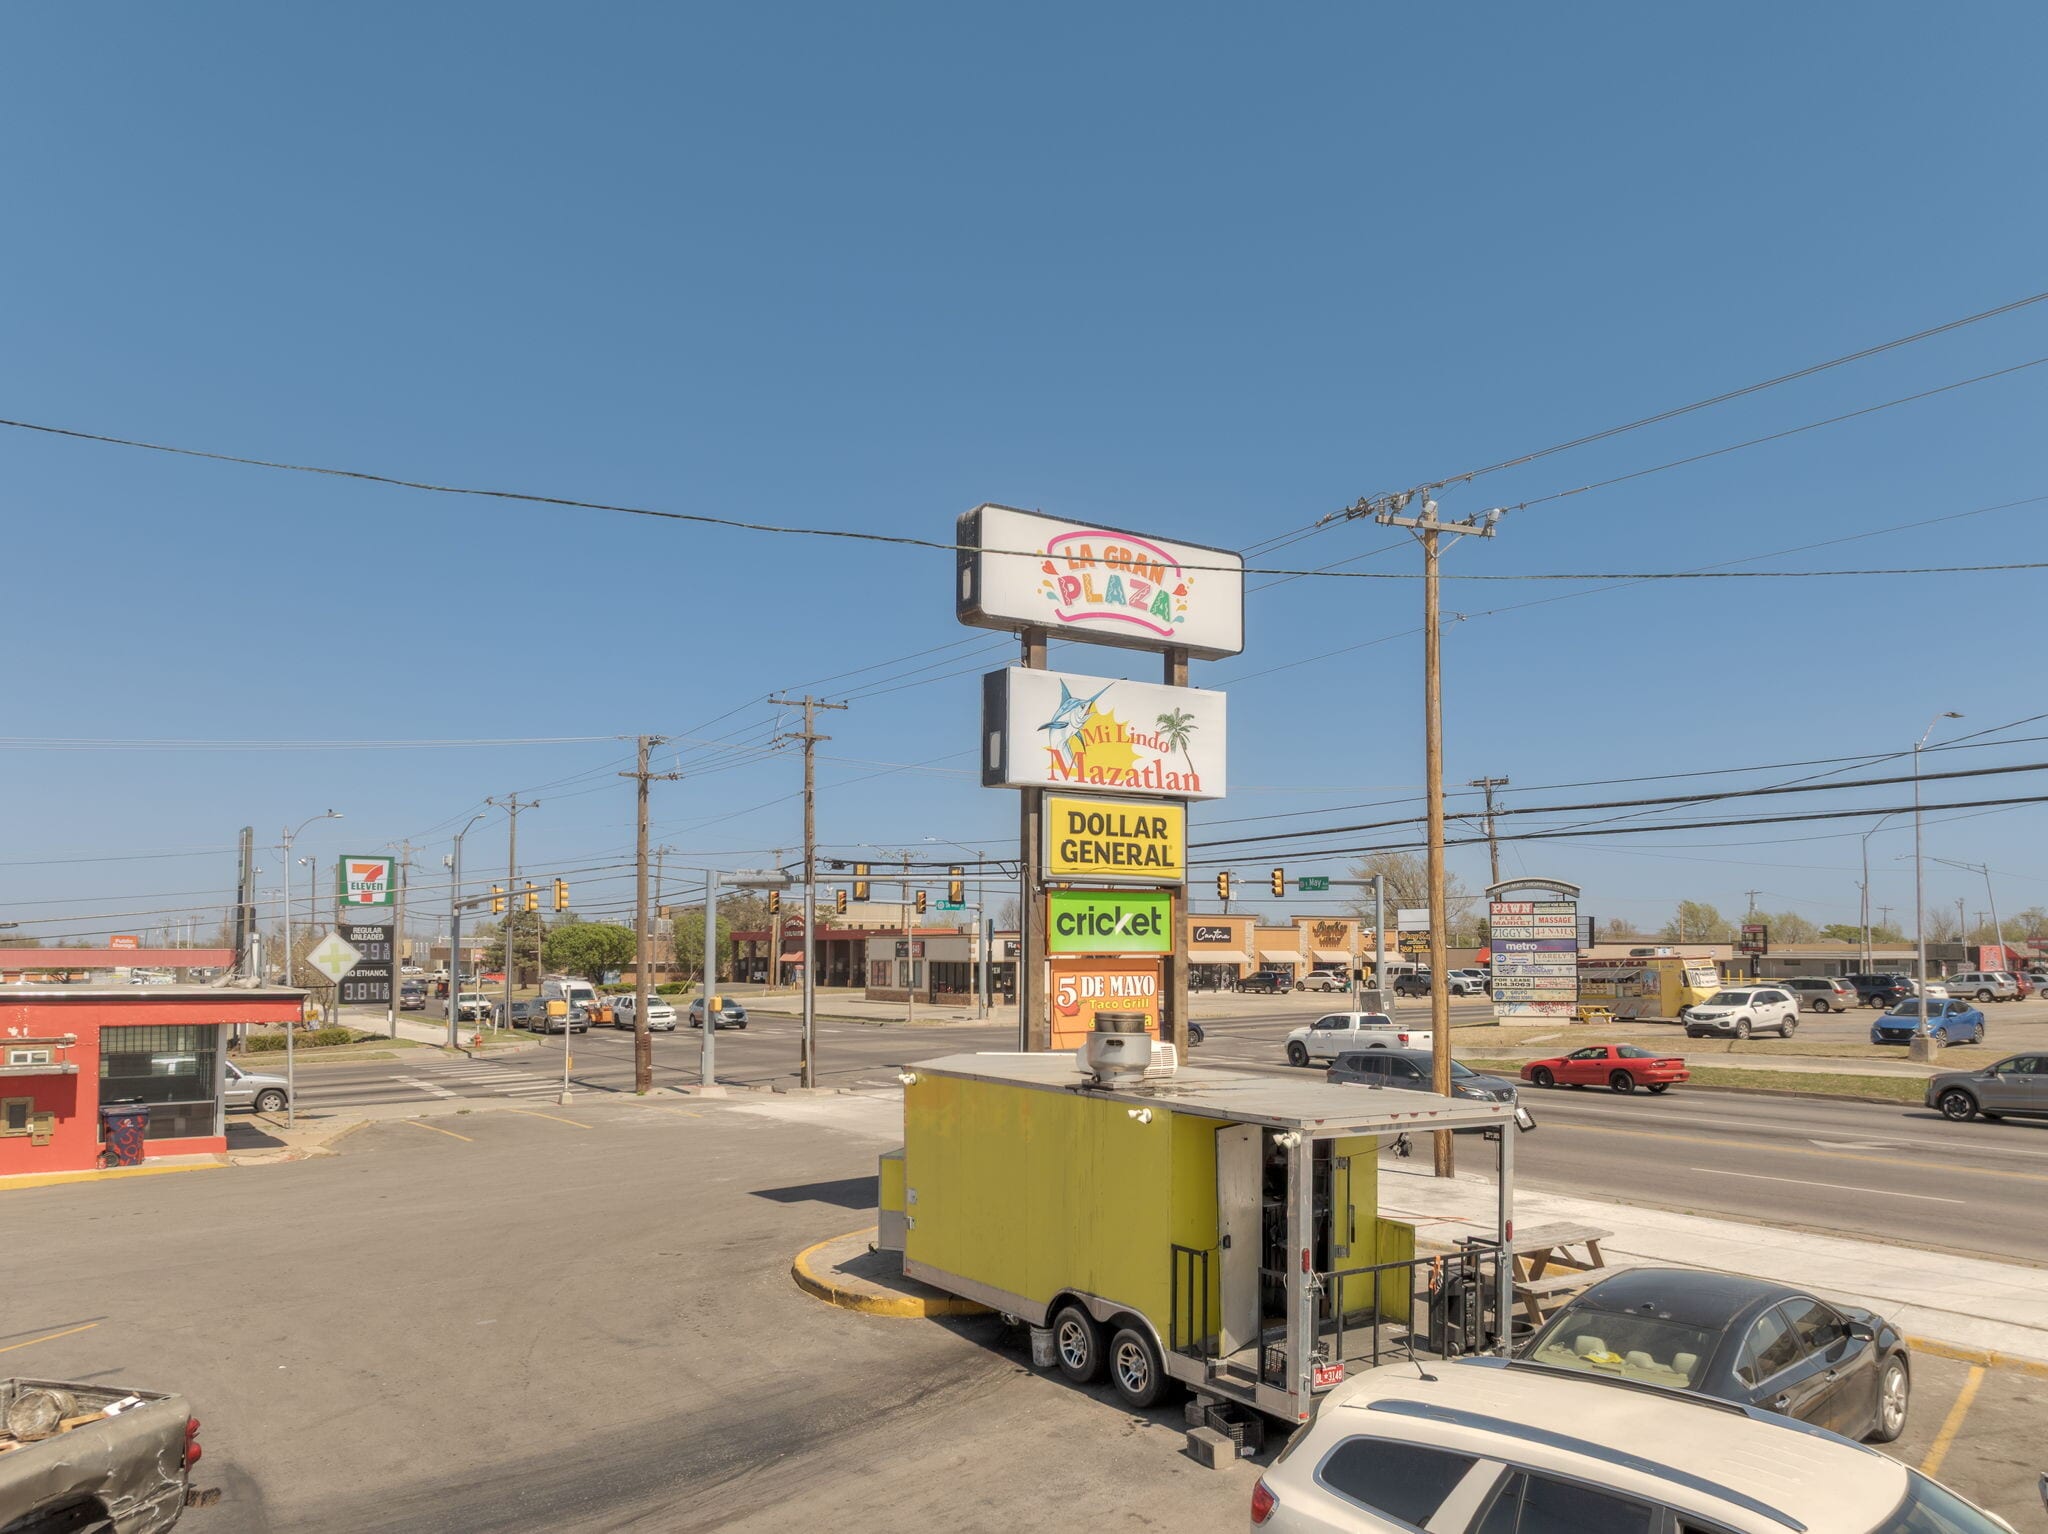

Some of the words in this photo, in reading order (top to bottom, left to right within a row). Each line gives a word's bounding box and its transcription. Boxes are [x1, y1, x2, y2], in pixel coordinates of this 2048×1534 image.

[1065, 543, 1096, 571] LA
[1103, 545, 1166, 587] GRAN
[1057, 573, 1171, 622] PLAZA
[1082, 726, 1110, 748] Mi
[1115, 723, 1171, 754] Lindo
[1047, 748, 1202, 792] Mazatlan
[1068, 810, 1168, 840] DOLLAR
[1060, 838, 1175, 867] GENERAL
[1310, 878, 1322, 888] May
[1493, 904, 1530, 913] PAWN
[1056, 906, 1161, 936] cricket
[350, 933, 384, 941] UNLEADED
[1196, 927, 1230, 941] Cantina
[1492, 929, 1532, 938] ZIGGY'S
[1505, 943, 1538, 951] metro
[357, 969, 389, 977] ETHANOL
[1056, 976, 1077, 1008] 5
[1080, 976, 1104, 998] DE
[1109, 975, 1155, 997] MAYO
[1088, 999, 1119, 1009] Taco
[1122, 999, 1149, 1009] Grill
